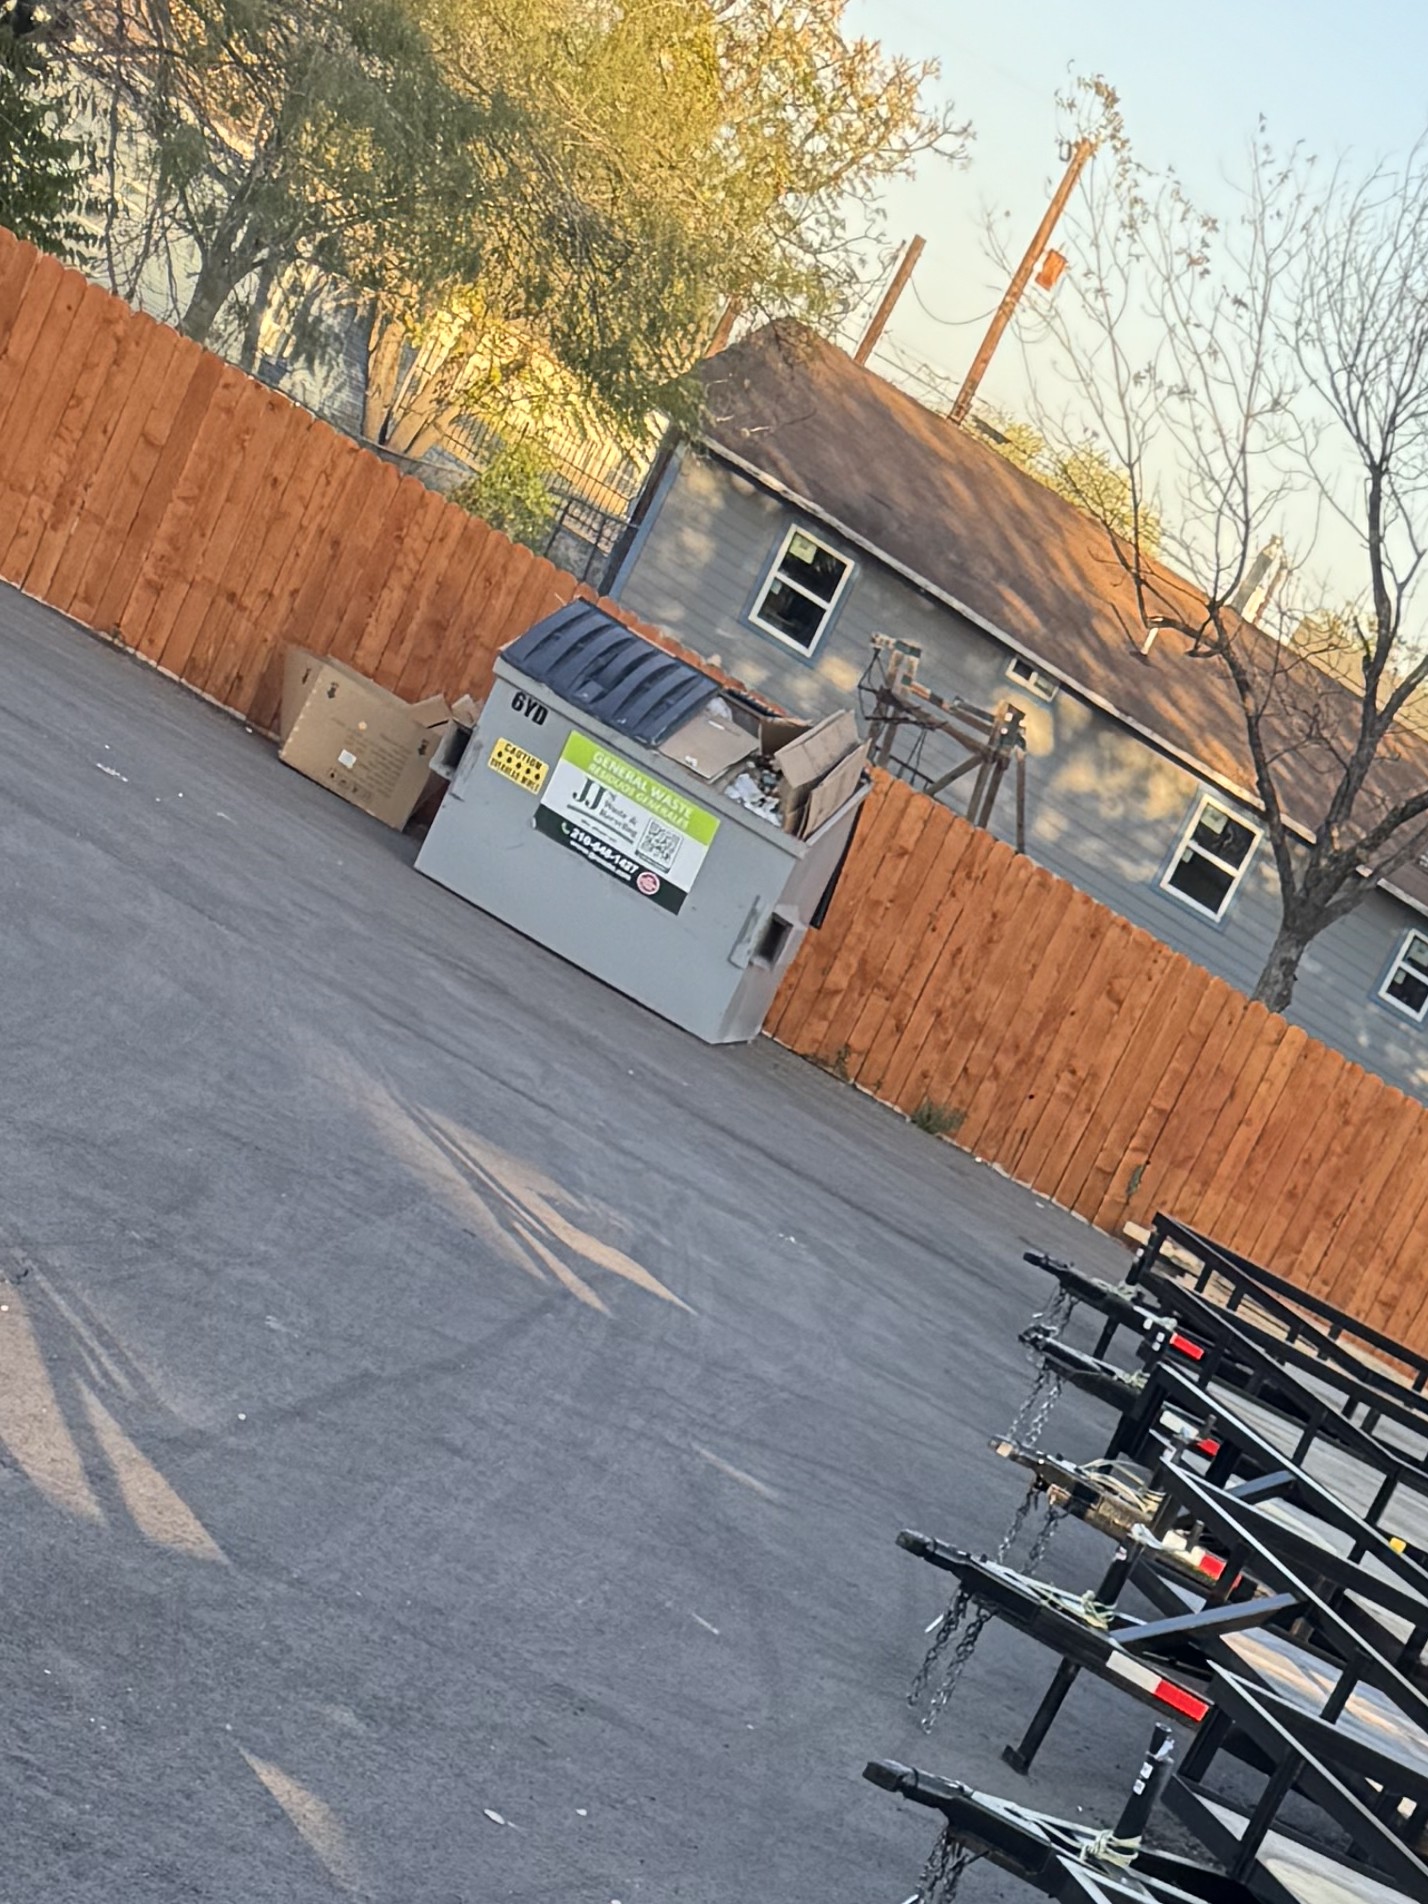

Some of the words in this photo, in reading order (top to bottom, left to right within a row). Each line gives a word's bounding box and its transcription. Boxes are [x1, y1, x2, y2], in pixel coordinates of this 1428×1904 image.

[511, 691, 548, 726] 6YD
[504, 743, 542, 770] CAUTION
[593, 751, 648, 792] GENERAL
[650, 786, 693, 819] WASTE
